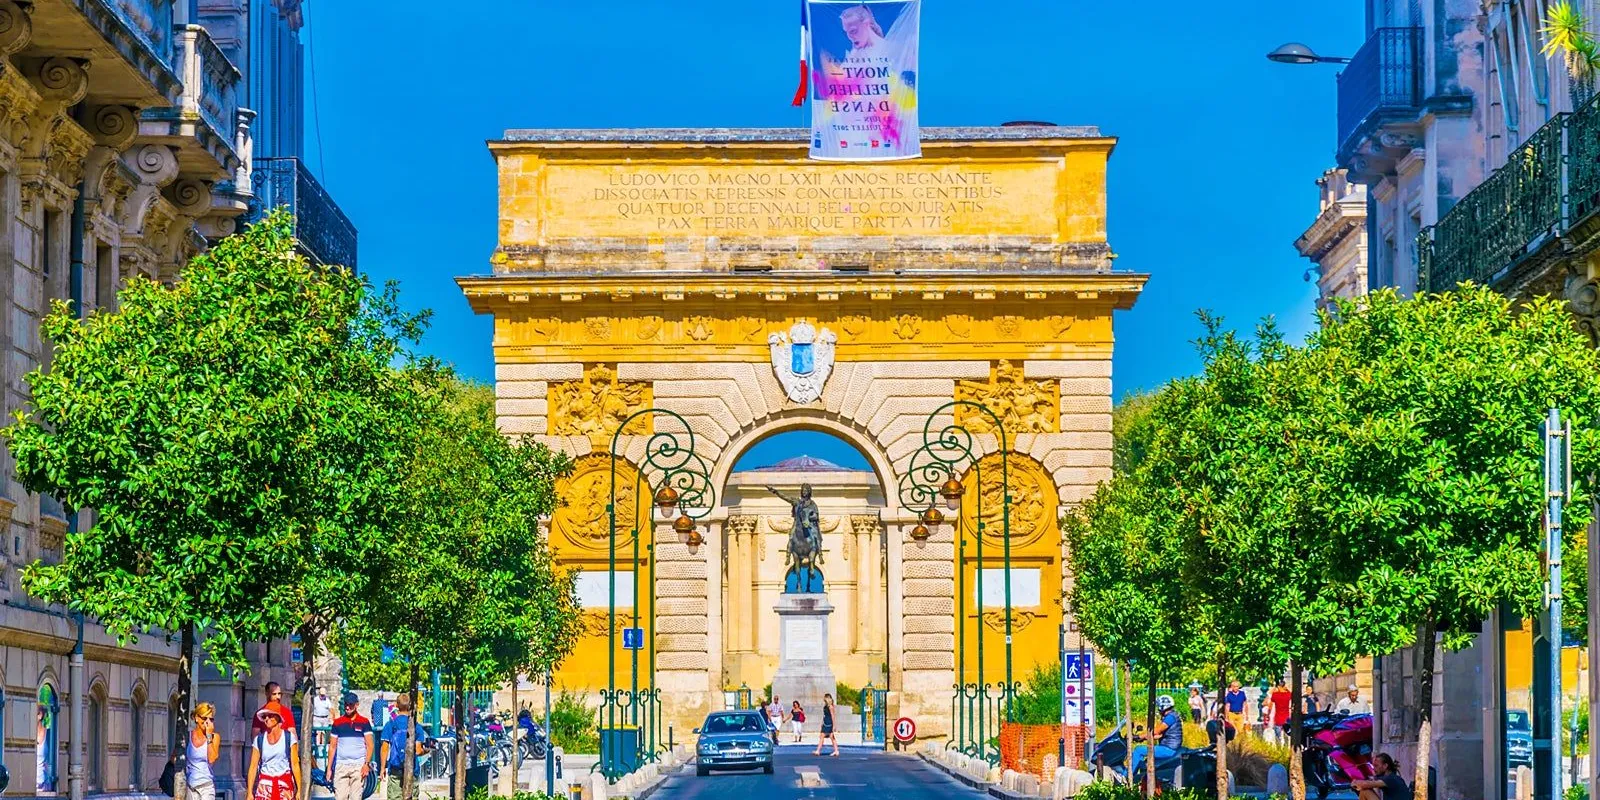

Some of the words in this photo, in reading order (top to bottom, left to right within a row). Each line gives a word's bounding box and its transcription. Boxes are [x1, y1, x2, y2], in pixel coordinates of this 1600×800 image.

[609, 173, 700, 186] LUDOVICO
[708, 173, 771, 185] MAGNO
[780, 173, 821, 185] LXXII
[831, 173, 887, 185] ANNOS
[896, 172, 992, 185] REGNANTE
[594, 188, 698, 200] DISSOCIATIS
[706, 187, 786, 200] REPRESSIS
[796, 187, 903, 200] CONCILIATIS
[912, 187, 1002, 199] GENTIBUS
[618, 202, 705, 218] QUATUOR
[714, 202, 810, 214] DECENNALI
[818, 202, 870, 214] BELLO
[880, 201, 984, 214] CONJURATIS
[657, 217, 691, 229] PAX
[701, 217, 759, 229] TERRA
[768, 216, 845, 231] MARIQUE
[852, 216, 912, 228] PARTA
[922, 215, 951, 228] 1715
